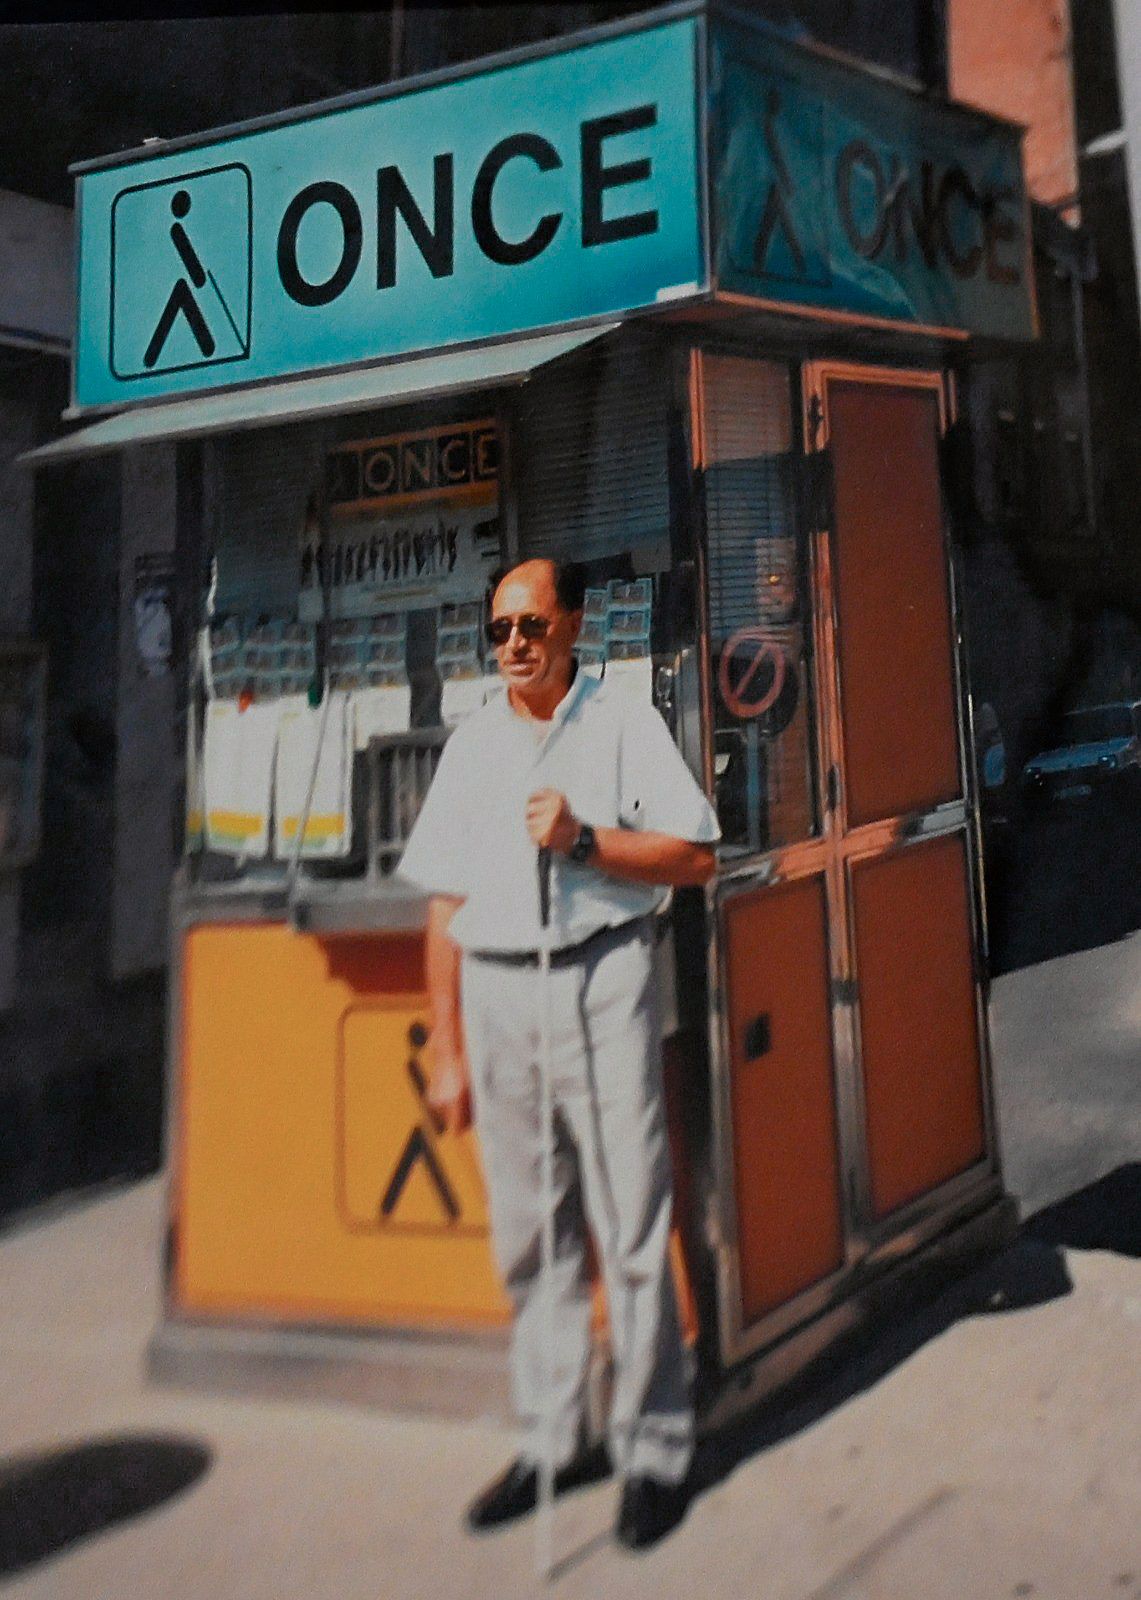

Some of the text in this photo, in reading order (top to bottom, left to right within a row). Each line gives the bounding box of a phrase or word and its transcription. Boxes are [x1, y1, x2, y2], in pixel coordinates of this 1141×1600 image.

[277, 104, 658, 306] ONCE
[837, 139, 1020, 285] ONCE
[365, 433, 498, 491] ONCE
